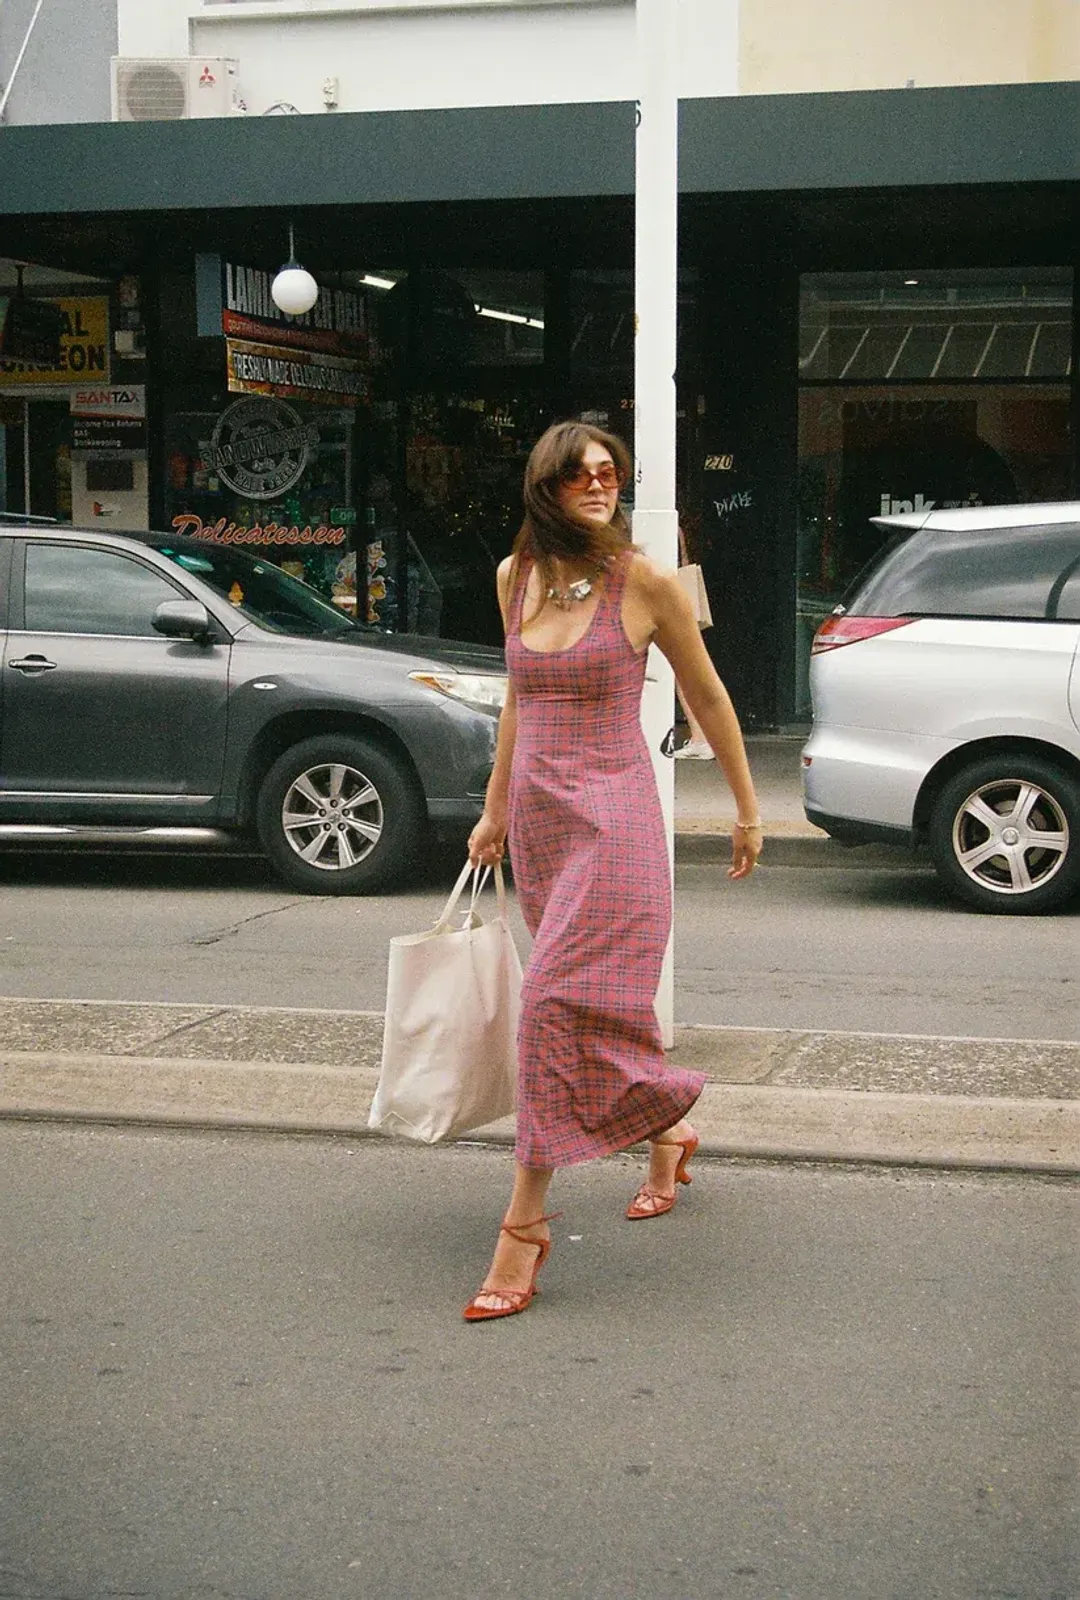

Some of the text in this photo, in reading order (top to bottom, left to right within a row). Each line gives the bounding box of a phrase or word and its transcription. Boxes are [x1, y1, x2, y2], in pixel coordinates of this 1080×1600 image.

[75, 390, 140, 404] SANTAX
[706, 455, 733, 469] 270
[880, 493, 936, 516] ink
[172, 514, 346, 545] Delicatessen
